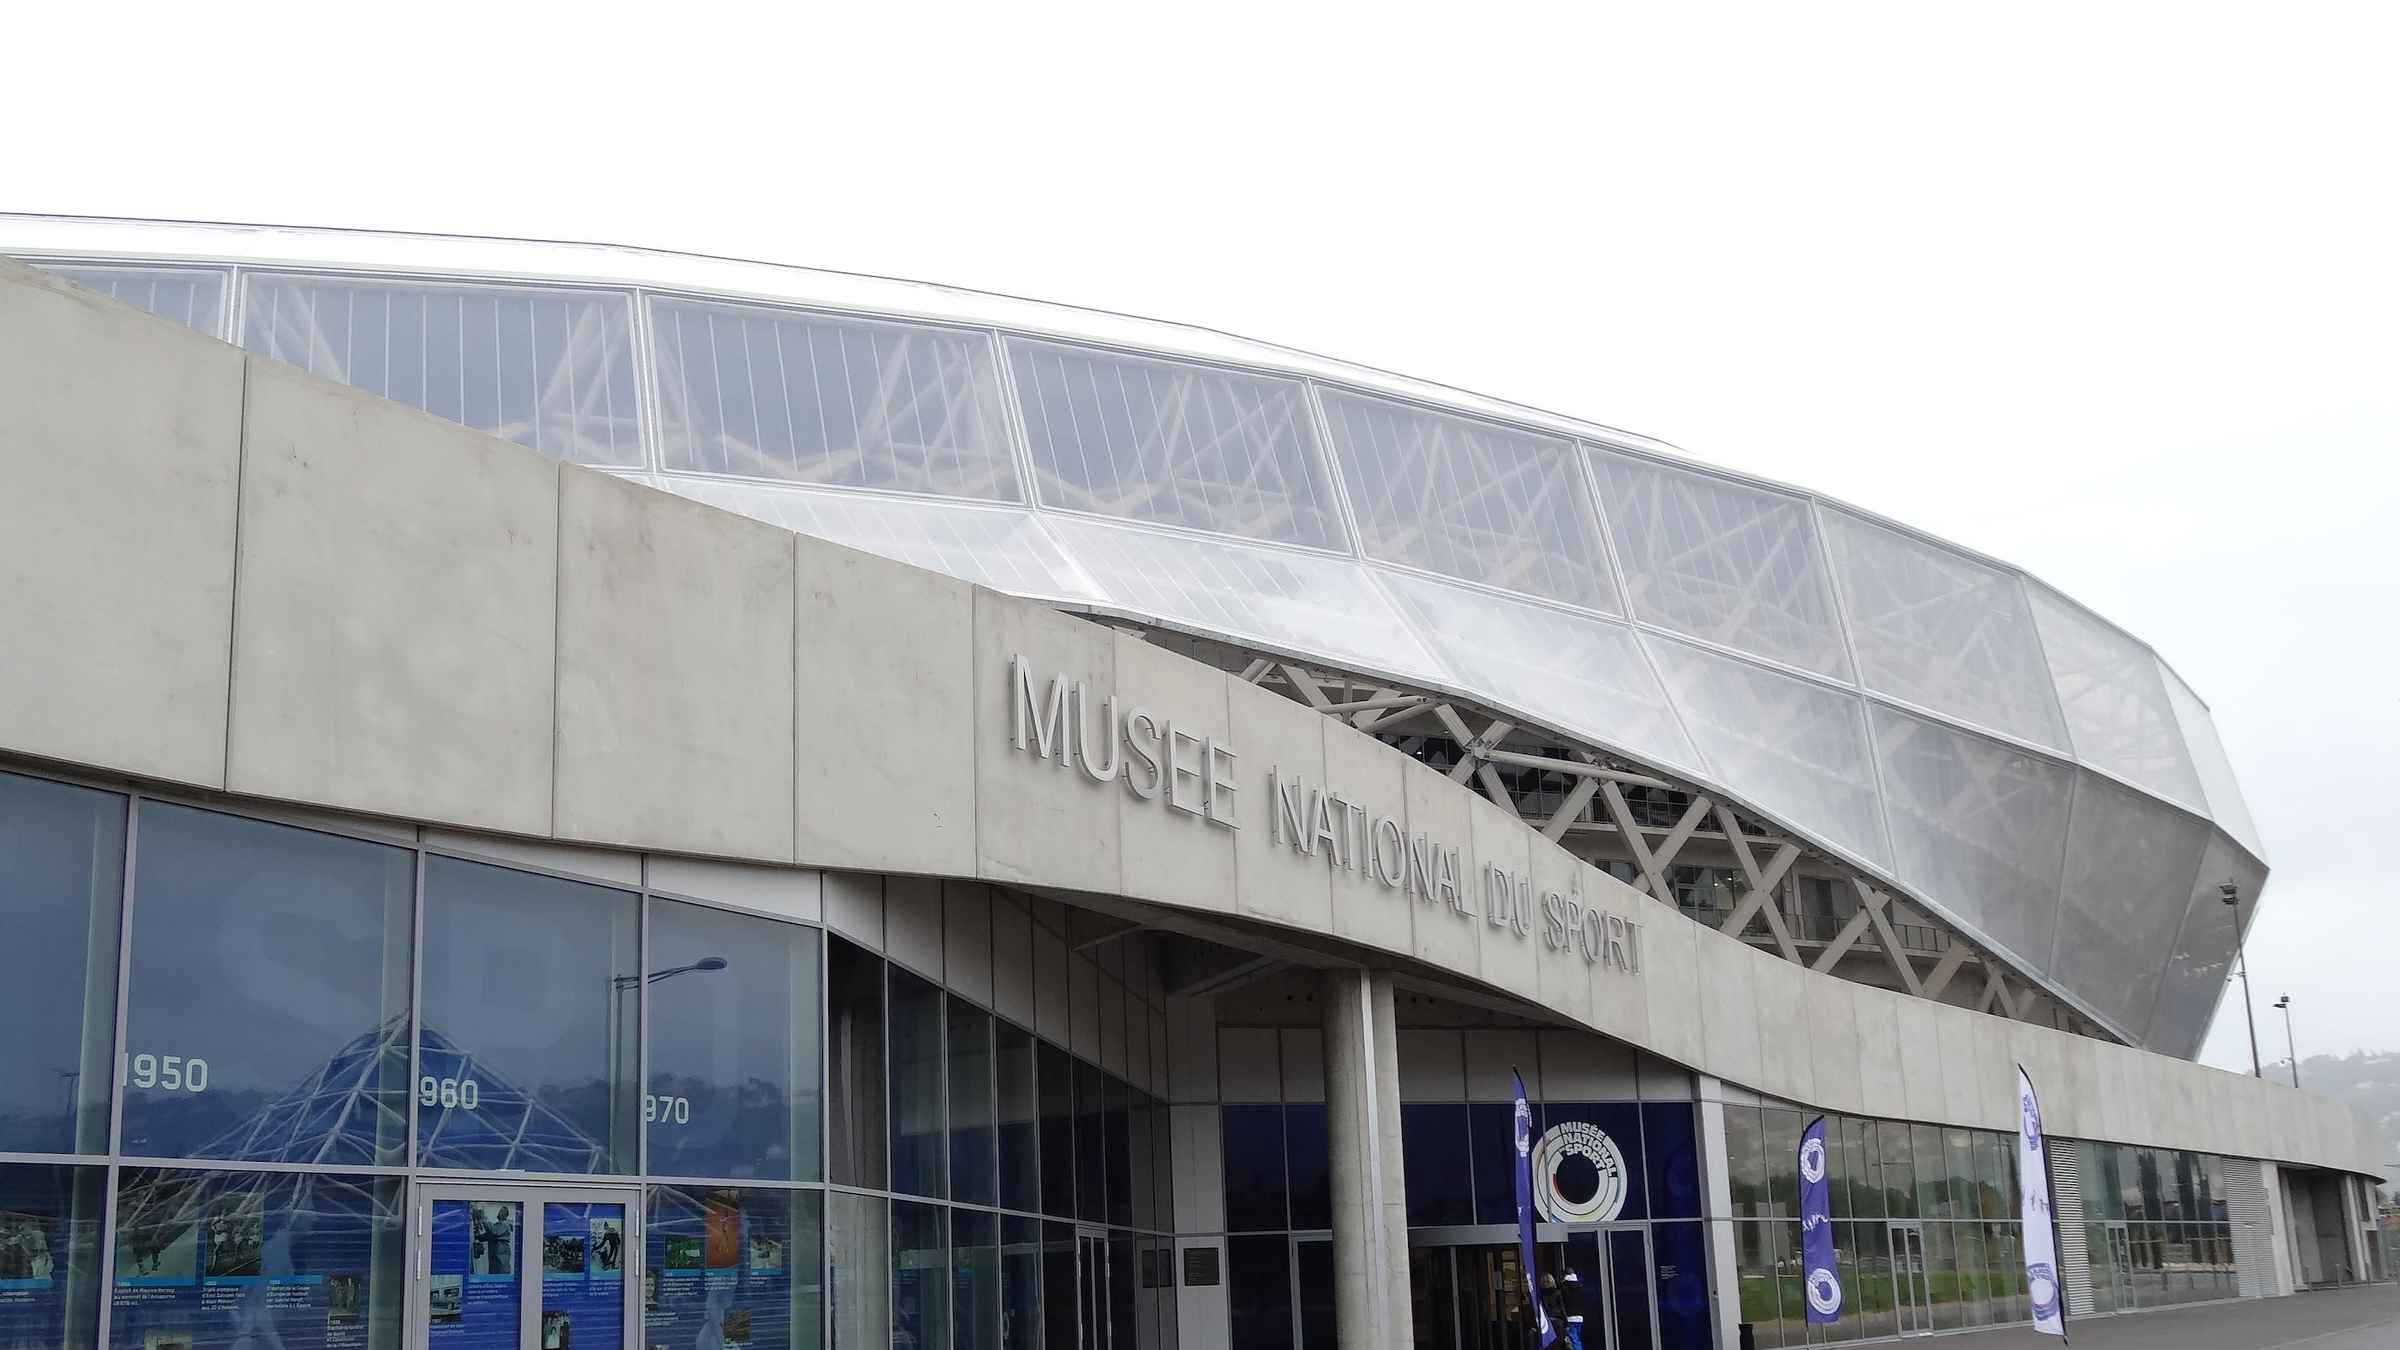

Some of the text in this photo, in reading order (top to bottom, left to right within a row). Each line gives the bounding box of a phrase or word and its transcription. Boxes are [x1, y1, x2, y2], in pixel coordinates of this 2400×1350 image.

[1012, 653, 1644, 976] MUSEE NATIONAL DU SPORT
[1562, 1132, 1618, 1177] NATIONAL
[1565, 1144, 1606, 1170] SPORT
